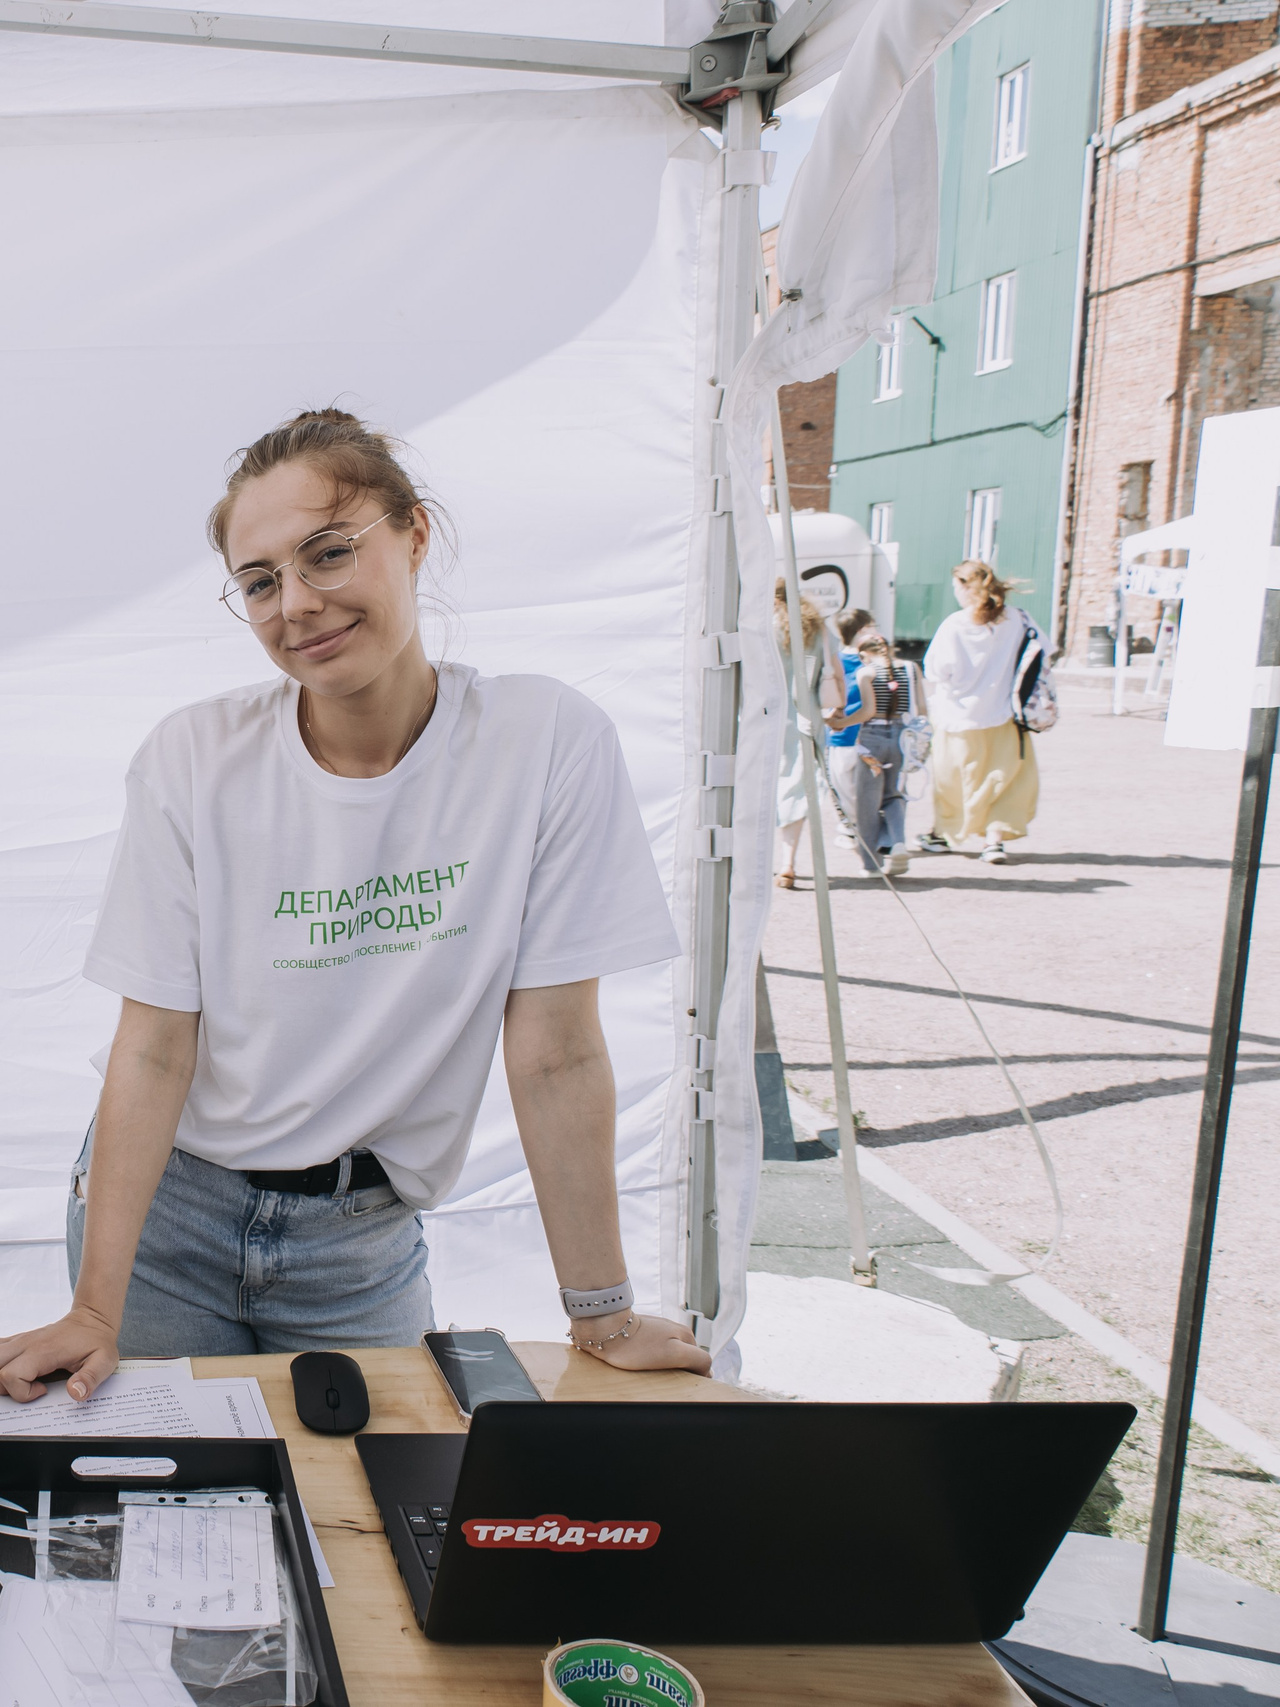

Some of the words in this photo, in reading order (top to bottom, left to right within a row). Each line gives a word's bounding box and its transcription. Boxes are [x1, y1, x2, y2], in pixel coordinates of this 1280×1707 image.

[274, 860, 470, 919] ДЕПАРТАМЕНТ
[309, 899, 443, 945] ПРИРОДЫ
[272, 953, 351, 970] СООБЩЕСТВО
[353, 940, 416, 958] ПОСЕЛЕНИЕ
[473, 1521, 649, 1545] ТРЕЙД-ИН
[147, 1593, 156, 1608] ФИО
